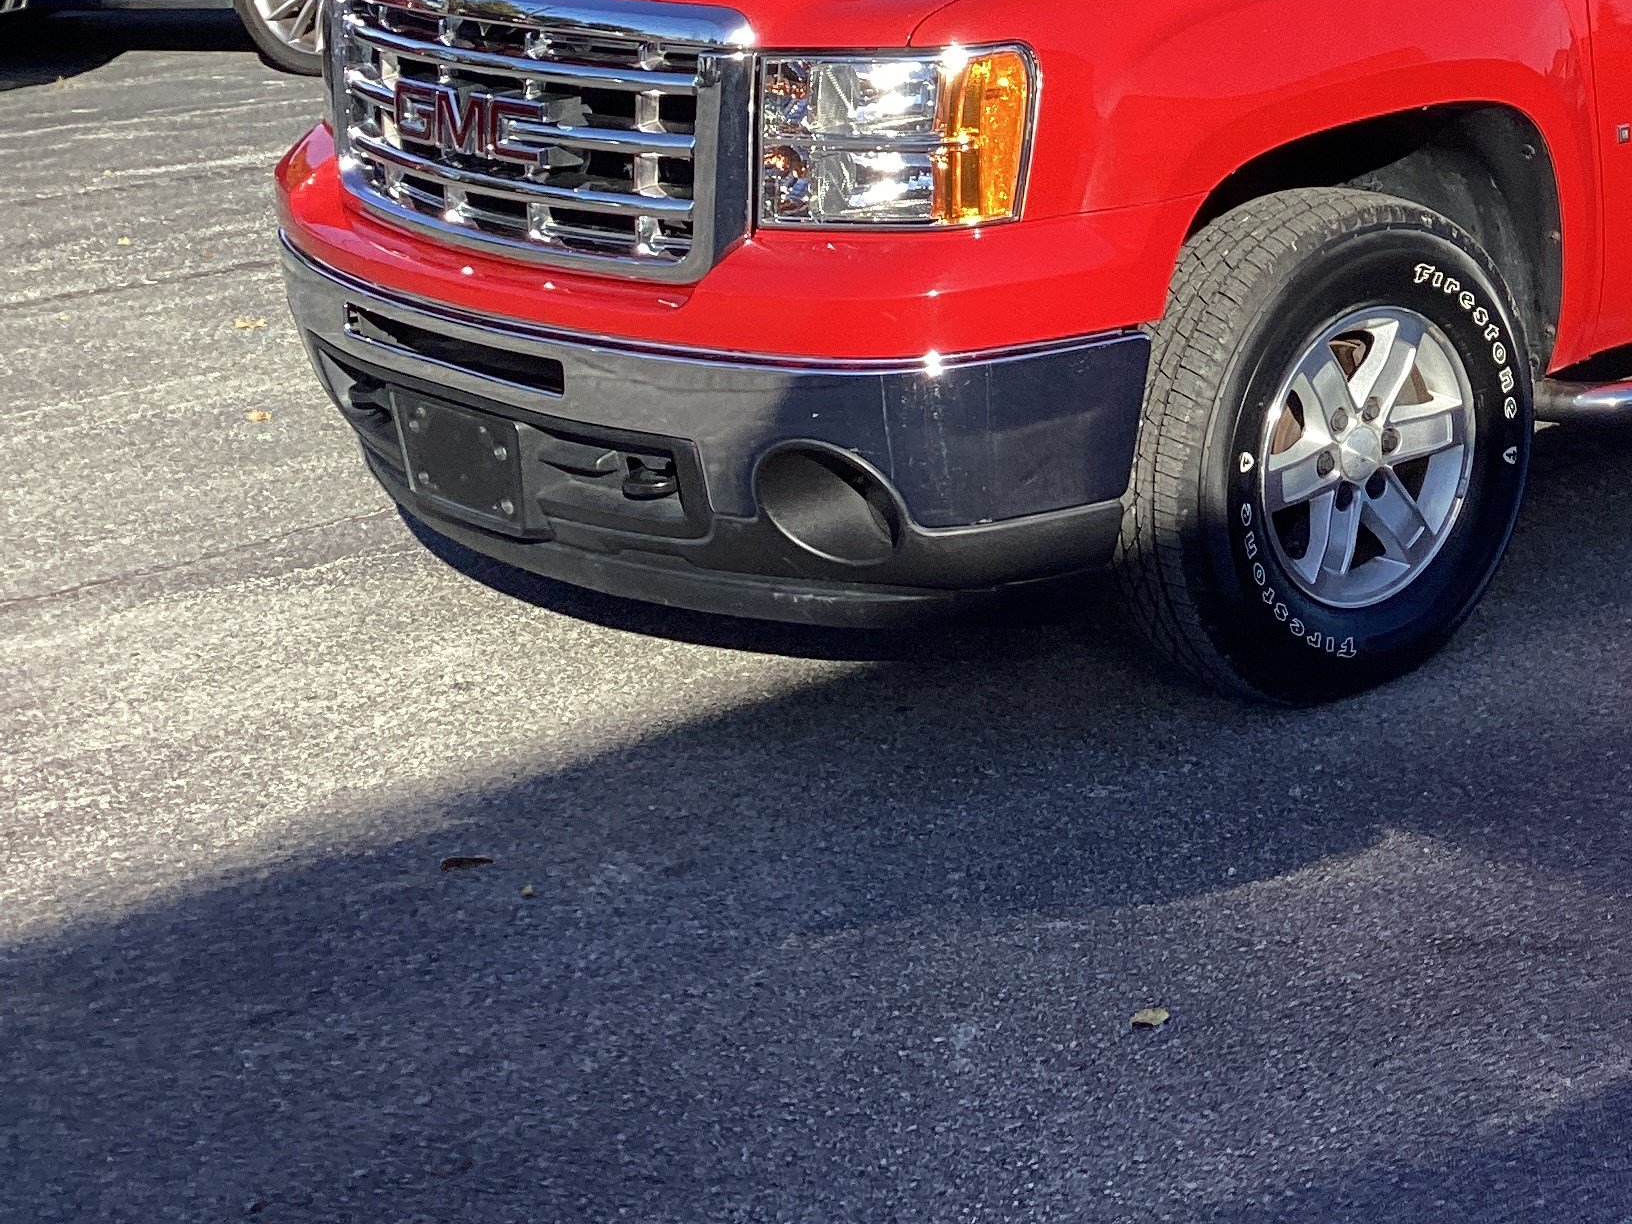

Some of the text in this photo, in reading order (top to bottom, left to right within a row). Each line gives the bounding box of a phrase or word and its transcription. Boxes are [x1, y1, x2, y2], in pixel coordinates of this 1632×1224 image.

[395, 77, 550, 167] GMC
[1413, 263, 1518, 420] Firestone
[1241, 502, 1357, 658] Firestone
